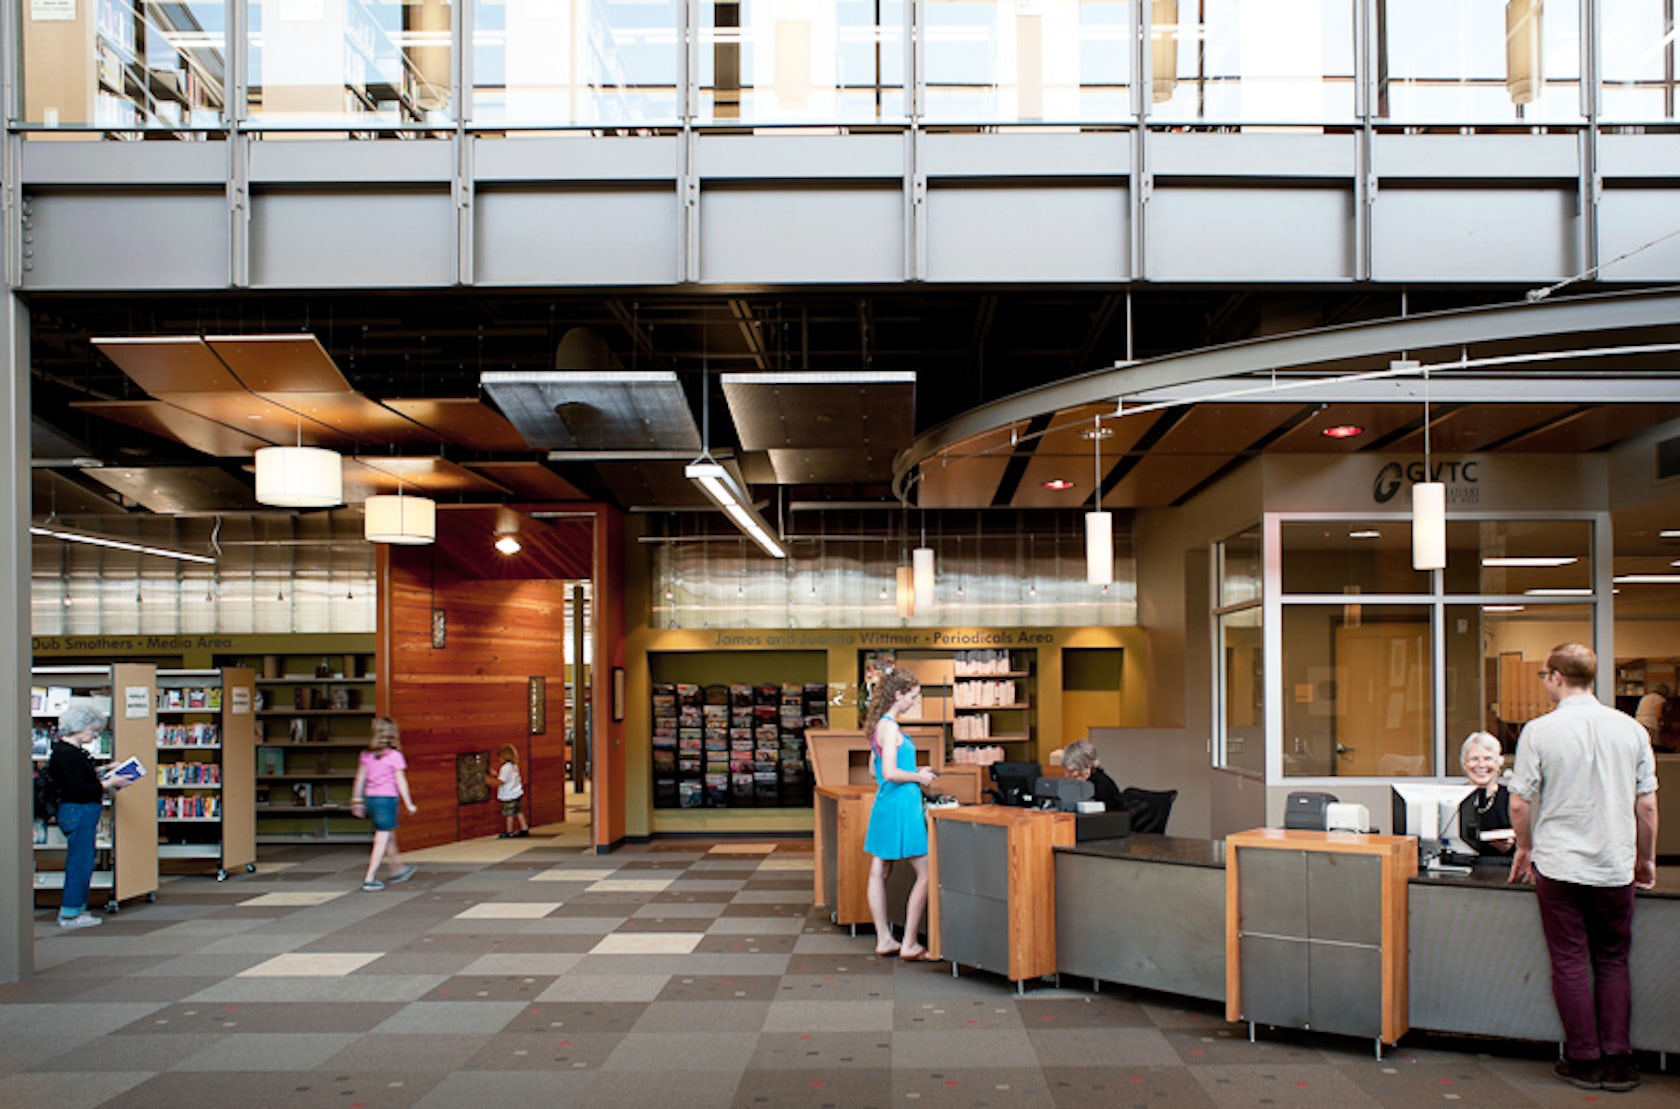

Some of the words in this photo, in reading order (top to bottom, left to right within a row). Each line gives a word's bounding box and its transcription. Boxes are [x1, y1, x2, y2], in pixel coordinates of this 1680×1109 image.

[1406, 462, 1479, 482] GVTC
[32, 637, 60, 650] Dub
[64, 636, 134, 650] Smothers
[146, 637, 192, 649] Media
[197, 636, 232, 649] Area
[715, 632, 762, 646] James
[766, 632, 795, 646] and
[801, 631, 855, 646] Juanita
[859, 630, 919, 645] Wittmer
[933, 631, 1013, 644] Periodicals
[1018, 631, 1054, 644] Area
